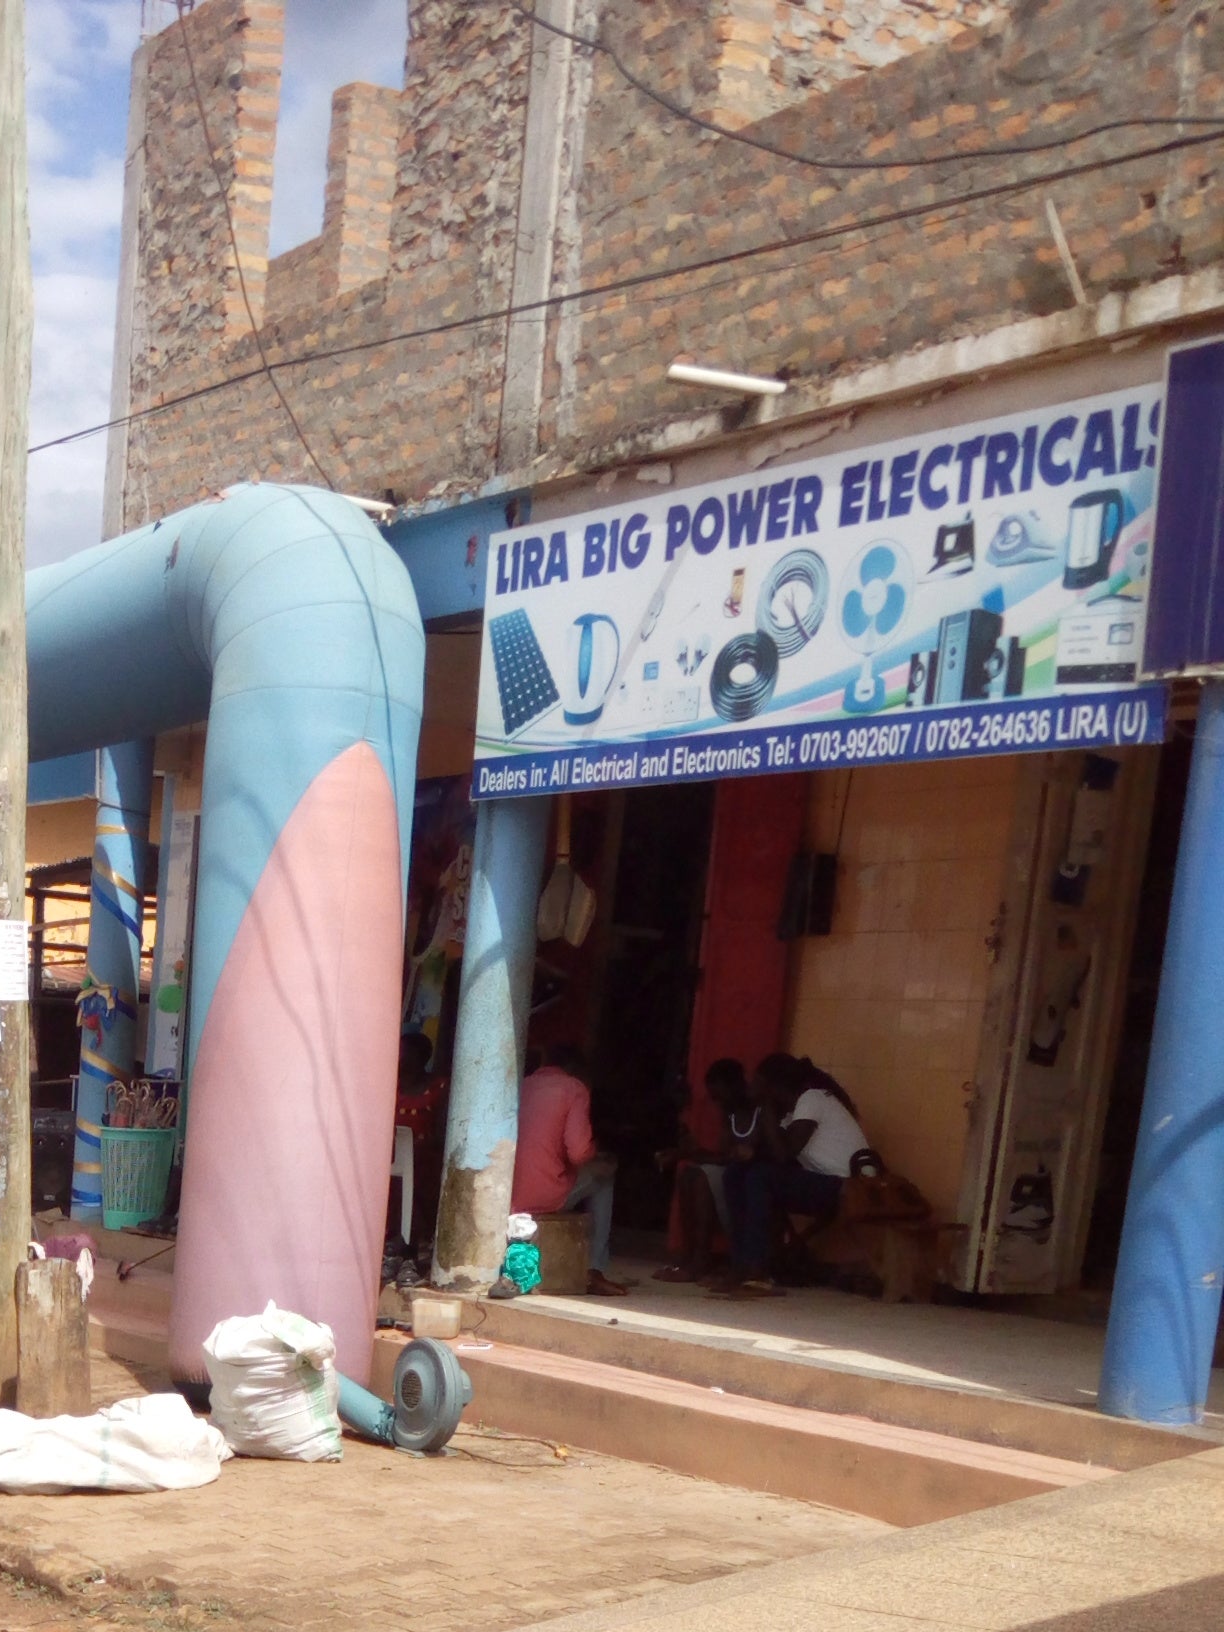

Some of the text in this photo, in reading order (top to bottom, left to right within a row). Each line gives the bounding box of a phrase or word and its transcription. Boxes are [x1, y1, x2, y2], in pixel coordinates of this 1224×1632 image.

[495, 531, 569, 595] LIRA
[582, 513, 652, 579] BIG
[665, 475, 824, 562] POWER
[479, 767, 527, 793] Dealers
[529, 763, 547, 788] in:
[550, 759, 567, 786] All
[572, 754, 637, 784] Electrical
[640, 749, 669, 777] and
[672, 742, 761, 776] Electronics
[766, 736, 796, 767] Tel:
[799, 724, 912, 764] 0703-992607
[926, 709, 1051, 751] 0782-264636
[1055, 704, 1109, 741] LIRA
[1114, 700, 1149, 744] (U)
